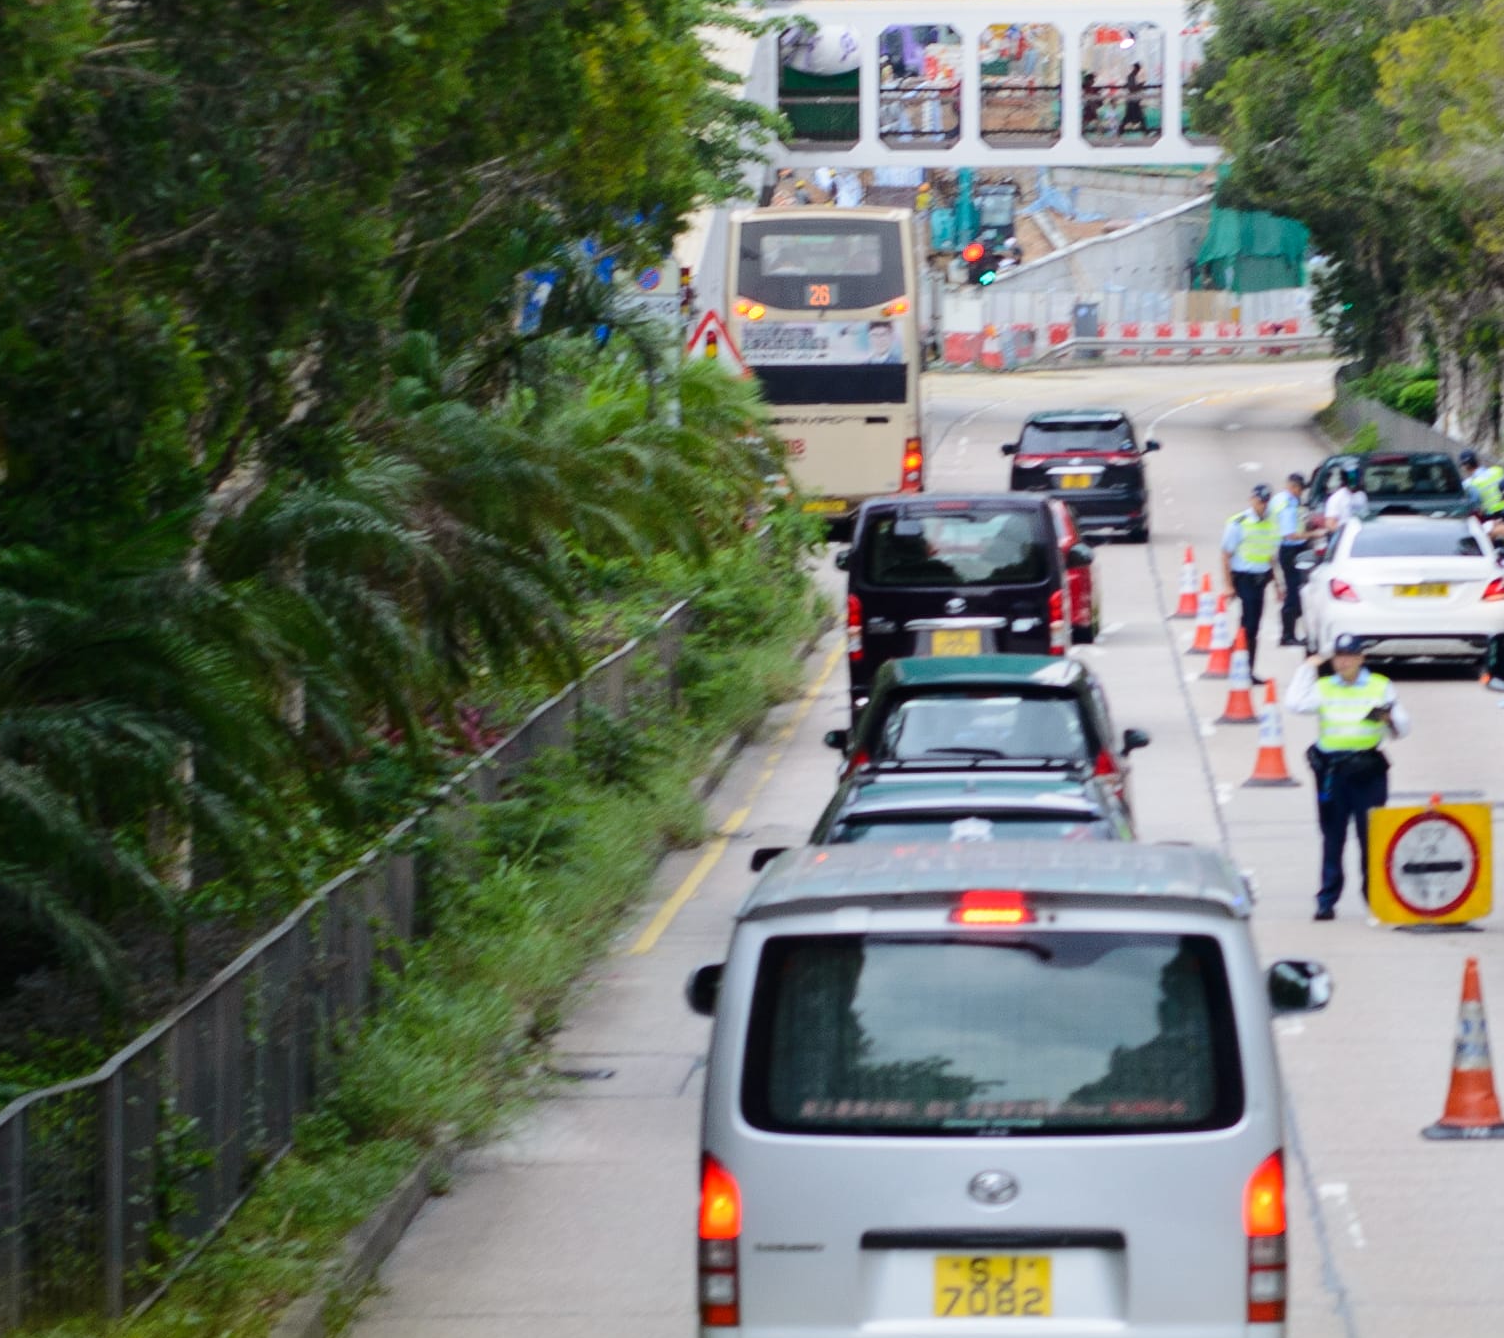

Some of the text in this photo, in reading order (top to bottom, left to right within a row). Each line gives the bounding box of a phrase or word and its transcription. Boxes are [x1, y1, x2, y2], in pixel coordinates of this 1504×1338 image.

[809, 285, 831, 306] 26
[969, 1257, 1017, 1287] SJ
[943, 1286, 1044, 1317] 7082
